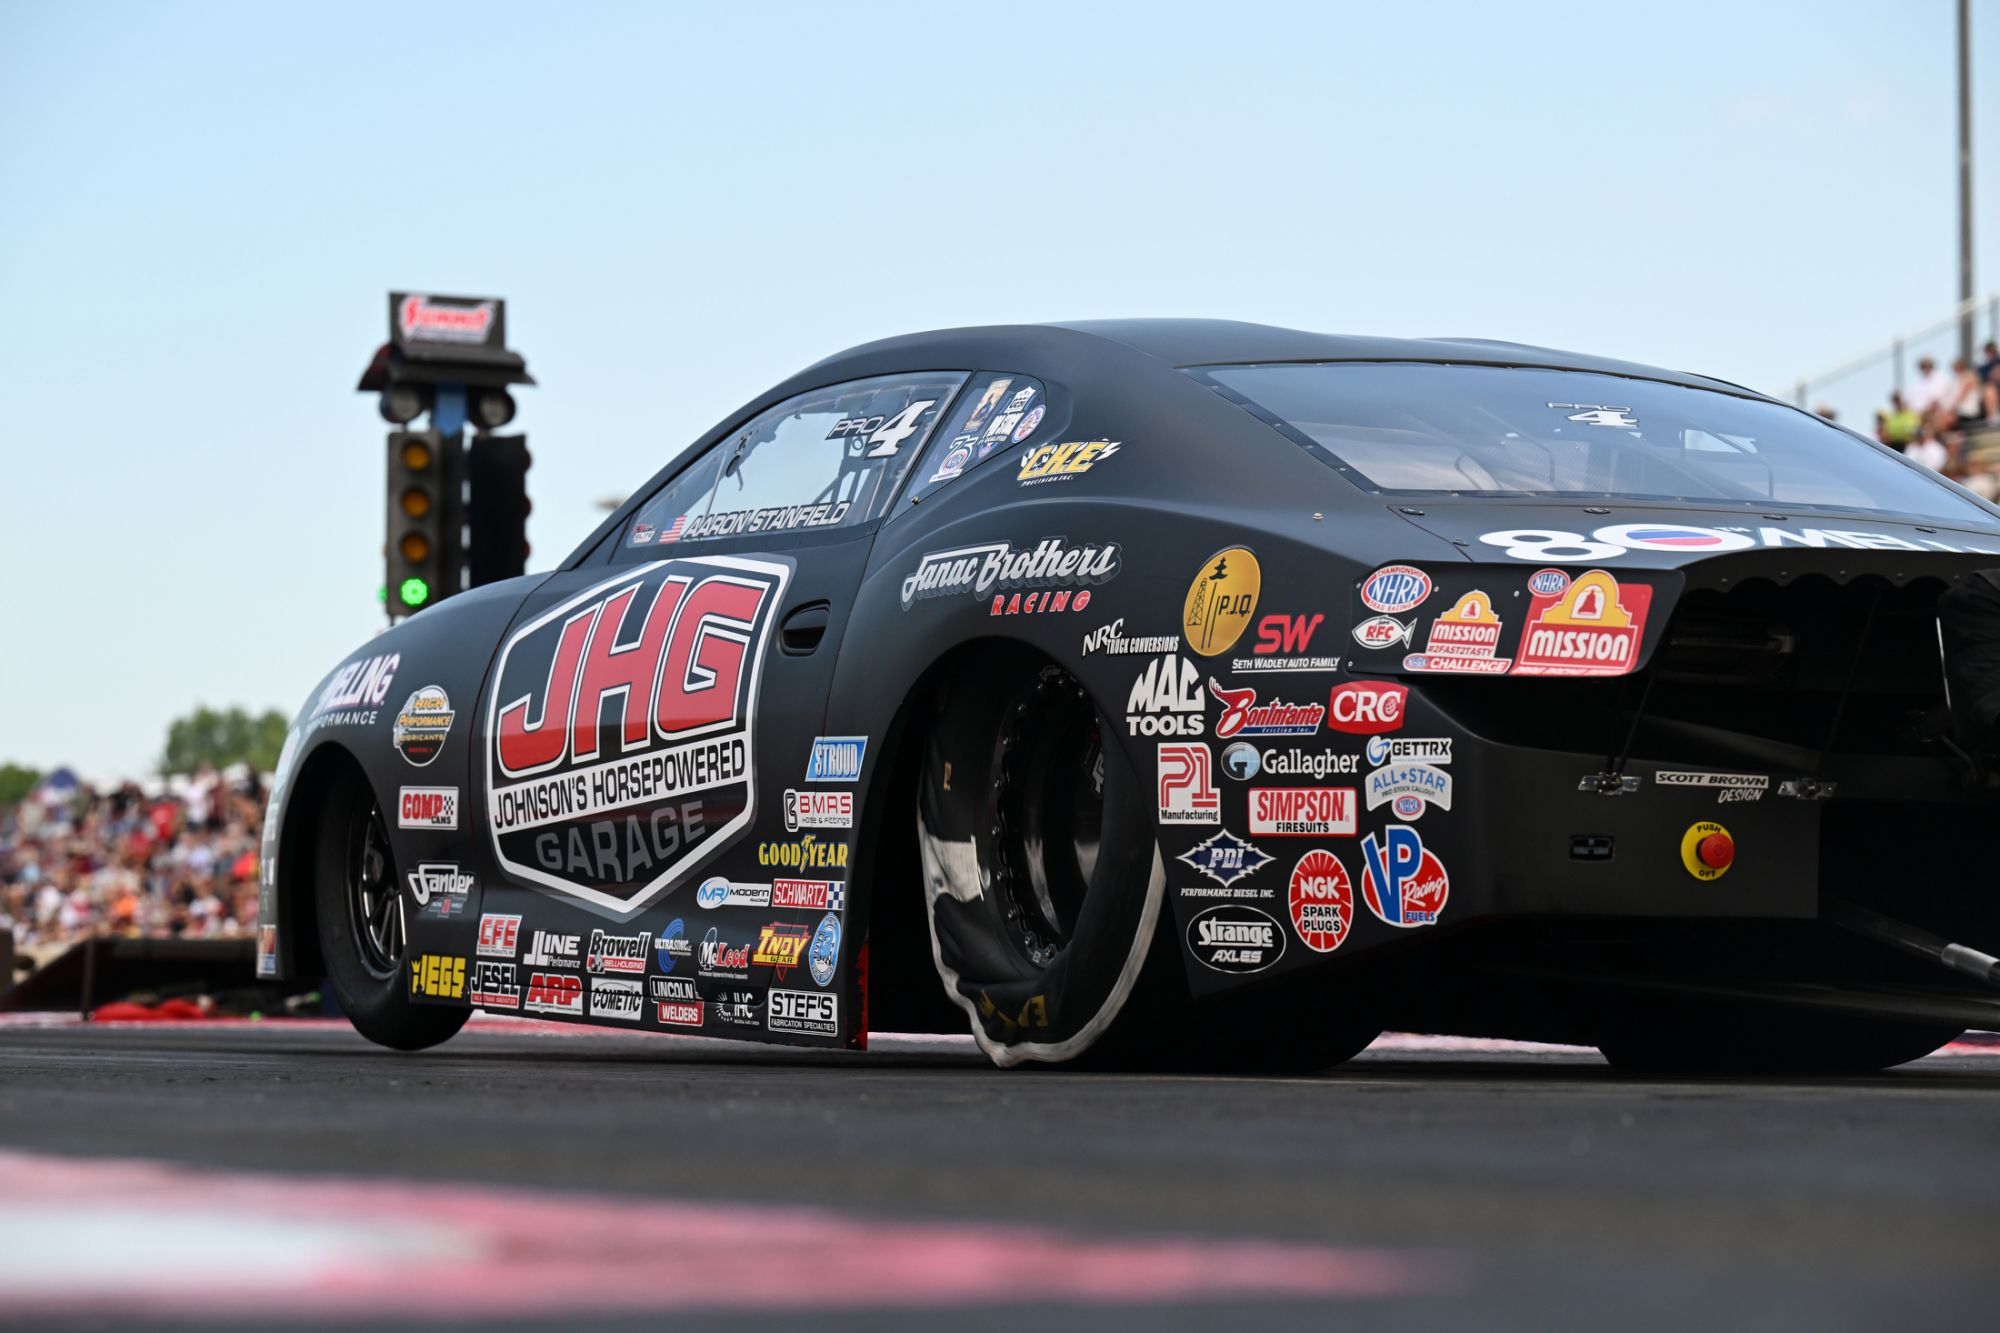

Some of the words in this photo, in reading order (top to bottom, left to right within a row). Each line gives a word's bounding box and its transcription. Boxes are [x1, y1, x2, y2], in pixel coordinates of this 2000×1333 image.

[827, 417, 884, 439] PRO
[864, 400, 935, 459] 4
[1567, 410, 1639, 428] 4
[683, 509, 750, 538] AARON
[749, 502, 851, 532] STANFIELD
[975, 540, 1117, 593] Brothers
[1370, 575, 1421, 604] NHRA
[1532, 573, 1566, 593] NHRA
[990, 590, 1091, 616] RACING
[1082, 617, 1124, 657] NRC
[1253, 613, 1325, 654] SW
[1365, 625, 1394, 639] RFC
[1432, 624, 1497, 643] MISSION
[1106, 638, 1129, 655] TRUCK
[1129, 636, 1180, 654] CONVERSIONS
[1427, 645, 1494, 657] #2FAST2TASTY
[1528, 629, 1630, 661] MISSION
[1232, 658, 1253, 670] SETH
[1254, 657, 1289, 669] WADLEY
[1287, 657, 1310, 668] AUTO
[1309, 656, 1341, 668] FAMILY
[1429, 657, 1507, 672] CHALLENGE
[498, 574, 771, 779] JHG
[1126, 653, 1206, 714] MAC
[1332, 691, 1401, 722] CRC
[1125, 714, 1205, 736] TOOLS
[814, 743, 859, 778] STROUD
[1392, 741, 1450, 757] GETTRX
[1262, 748, 1361, 780] Gallagher
[493, 770, 588, 830] JOHNSON'S
[592, 738, 746, 808] HORSEPOWERED
[1160, 746, 1218, 808] P1
[1373, 769, 1399, 793] ALL
[1409, 767, 1446, 793] STAR
[1657, 773, 1704, 783] SCOTT
[1708, 774, 1767, 787] BROWN
[402, 793, 444, 820] COMP
[799, 795, 852, 815] BMRS
[1256, 791, 1346, 822] SIMPSON
[1717, 788, 1764, 804] DESIGN
[1160, 808, 1218, 822] Manufacturing
[1276, 822, 1330, 833] FIRESUITS
[1696, 823, 1722, 833] PUSH
[535, 800, 707, 884] GARAGE
[1207, 847, 1246, 869] PDI
[408, 864, 475, 905] Sander
[1360, 825, 1423, 924] VP
[1698, 869, 1717, 878] OFF
[773, 882, 826, 906] SCHWARTZ
[1180, 888, 1233, 898] PERFORMANCE
[1232, 888, 1259, 898] DIESEL
[1259, 889, 1276, 899] INC.
[1299, 875, 1341, 900] NGK
[1403, 875, 1446, 911] Racing
[1302, 905, 1339, 918] SPARK
[1405, 911, 1436, 922] FUELS
[479, 918, 520, 947] CFE
[1197, 916, 1274, 947] Strange
[1302, 919, 1341, 932] PLUGS
[589, 932, 650, 959] Browell
[654, 938, 689, 952] ULTRASONIC
[700, 941, 751, 969] McLeod
[1210, 949, 1263, 963] AXLES
[412, 954, 467, 999] JEGS
[470, 963, 521, 997] JESEL
[526, 974, 583, 1006] ARP
[592, 987, 642, 1012] COMETIC
[652, 980, 695, 1000] LINCOLN
[662, 1005, 699, 1022] WELDERS
[771, 992, 833, 1021] STEF'S
[771, 1018, 803, 1029] FABRICATION
[803, 1020, 835, 1031] SPECIALTIES
